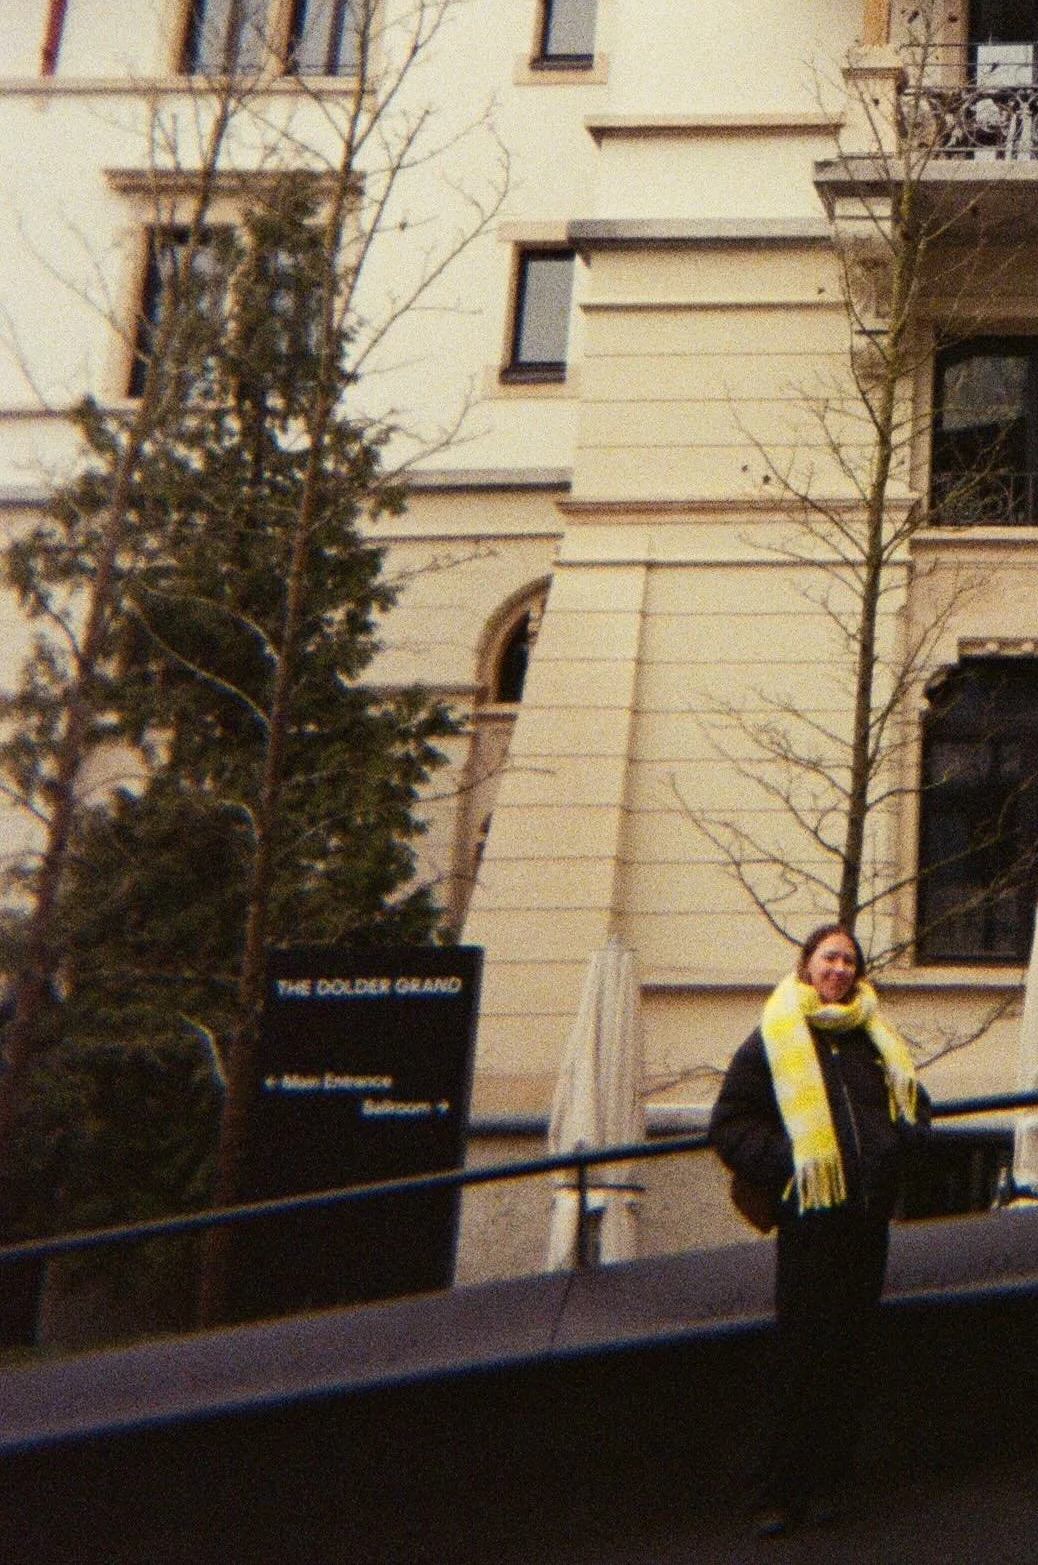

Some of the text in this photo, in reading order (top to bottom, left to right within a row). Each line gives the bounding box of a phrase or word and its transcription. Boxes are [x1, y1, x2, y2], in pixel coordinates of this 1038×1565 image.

[277, 976, 463, 997] THE DOLDER GRAND
